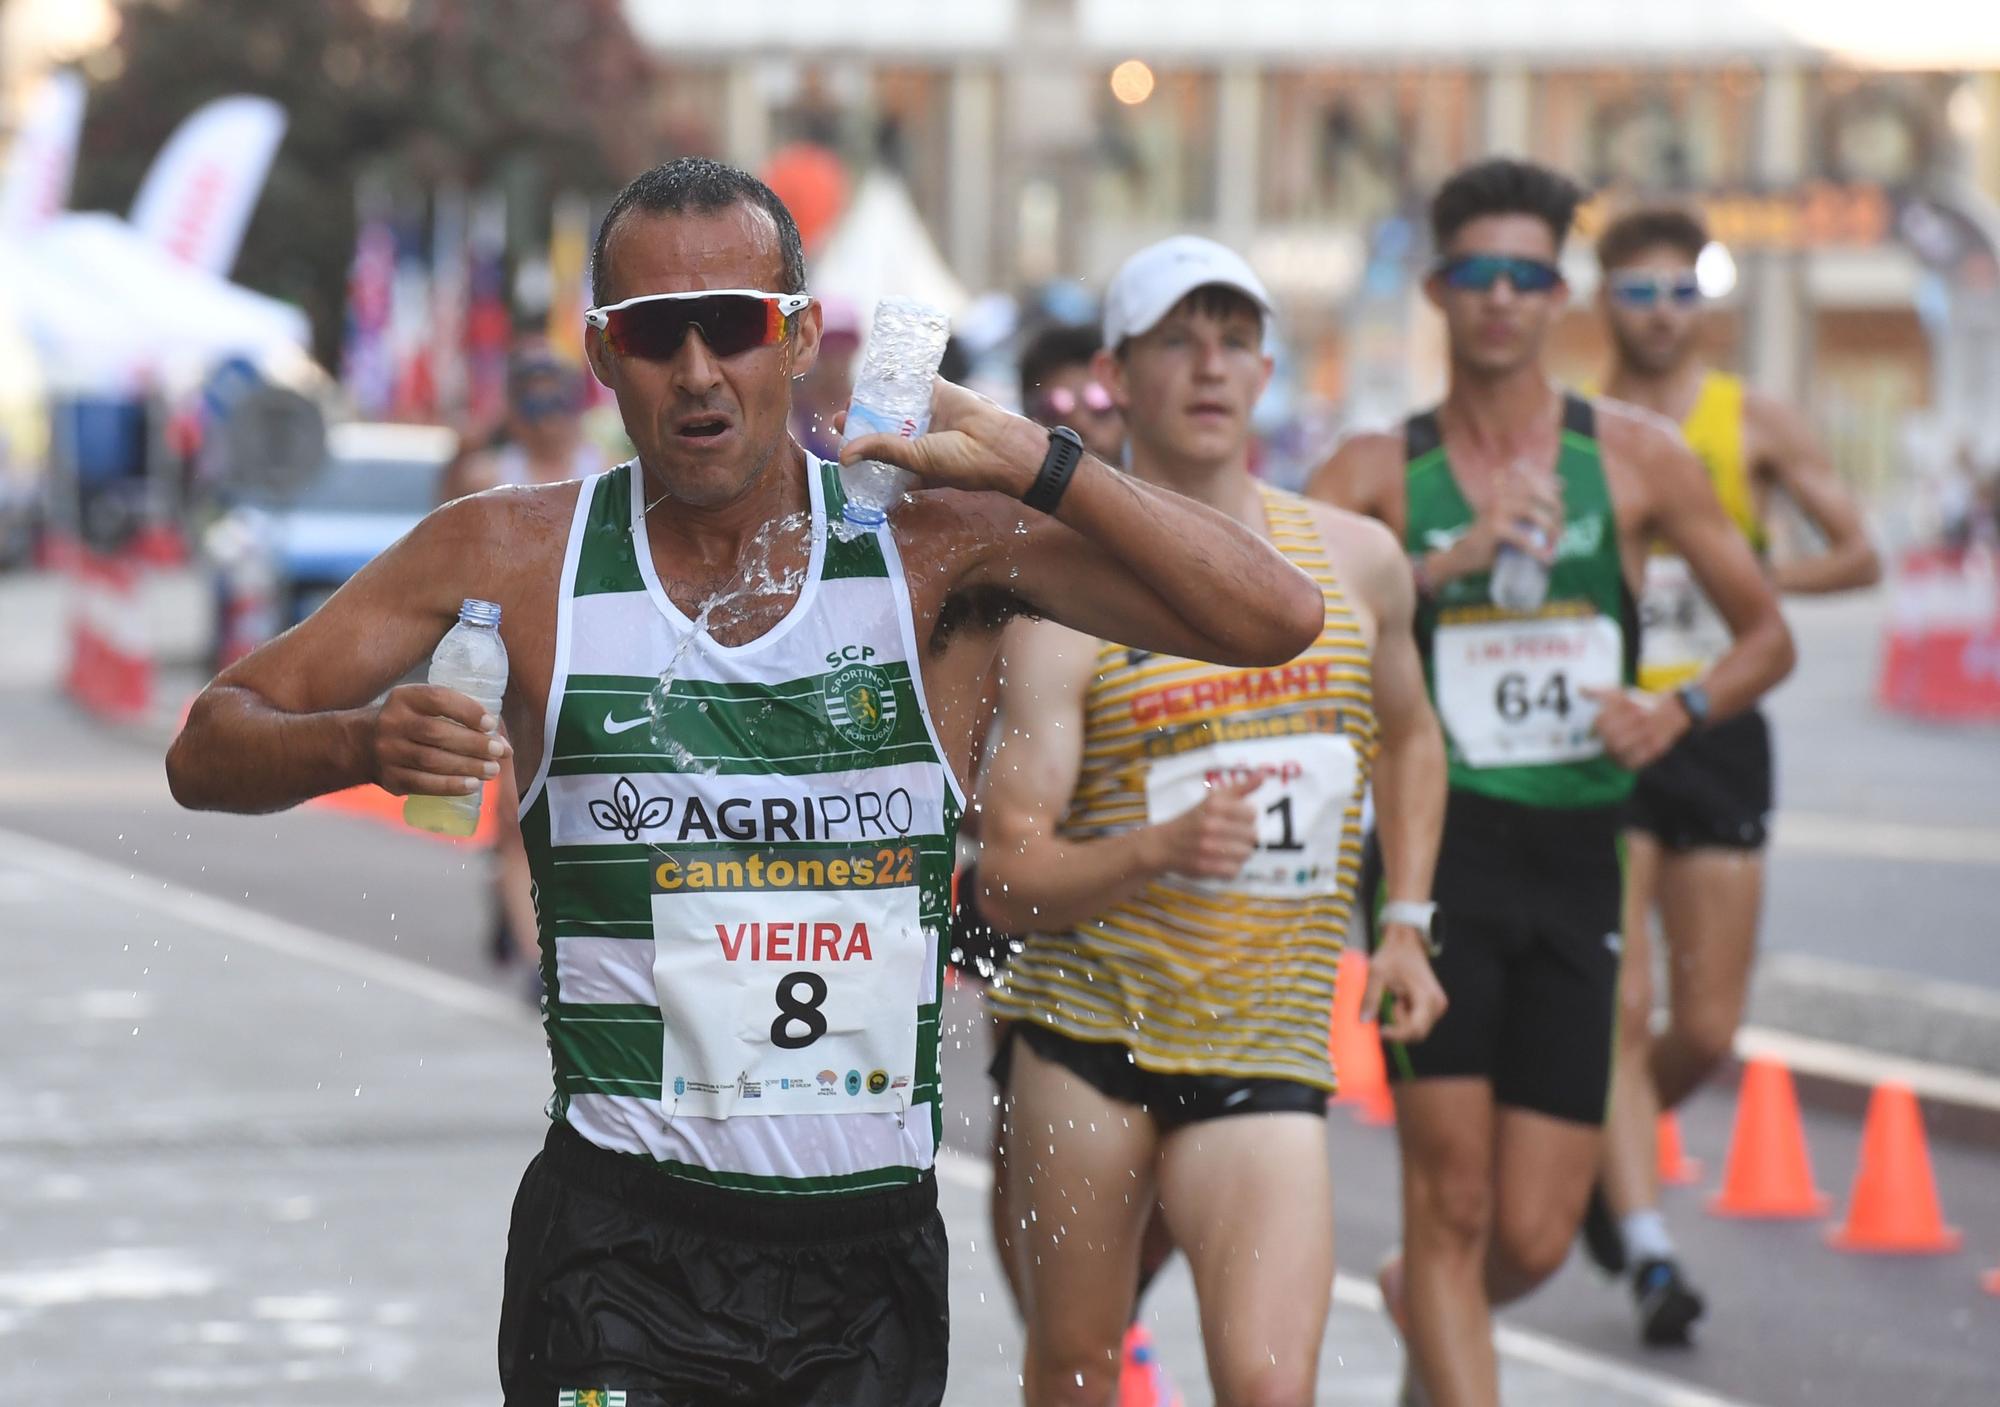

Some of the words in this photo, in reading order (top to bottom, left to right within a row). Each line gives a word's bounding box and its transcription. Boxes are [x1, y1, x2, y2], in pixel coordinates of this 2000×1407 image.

[826, 645, 875, 668] SCP
[831, 669, 885, 694] SPORTING
[1131, 662, 1329, 724] GERMANY
[1495, 672, 1571, 723] 64
[845, 725, 891, 742] PORTUGAL
[677, 787, 913, 842] AGRIPRO
[655, 847, 914, 889] cantones22
[715, 922, 873, 962] VIEIRA
[770, 971, 827, 1050] 8
